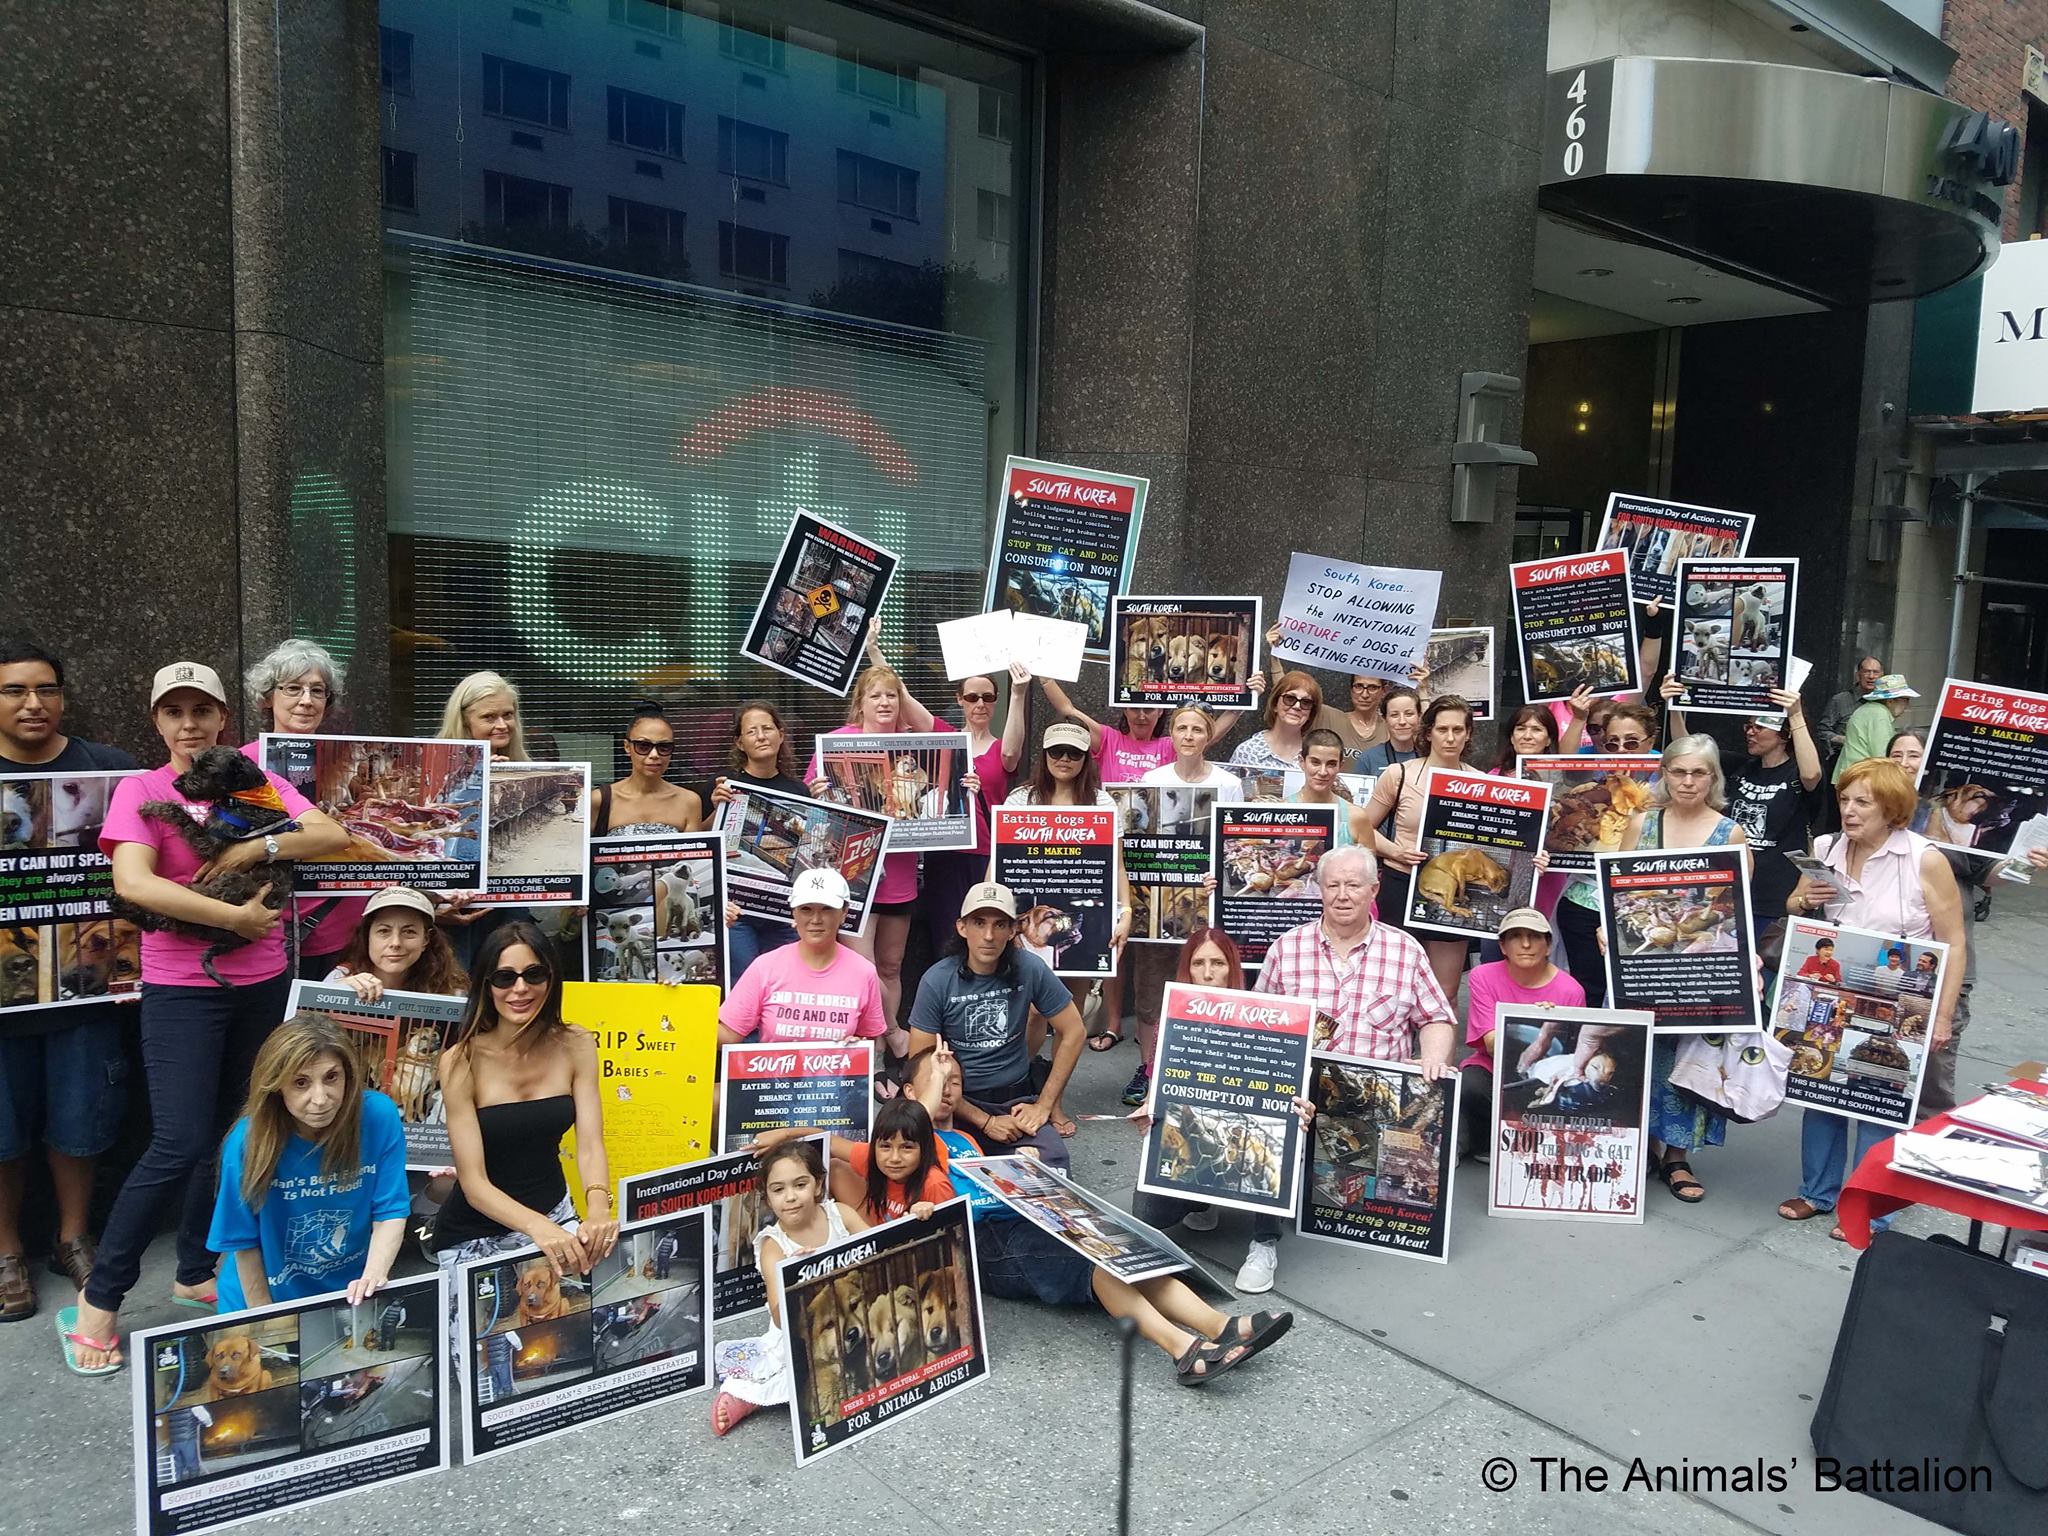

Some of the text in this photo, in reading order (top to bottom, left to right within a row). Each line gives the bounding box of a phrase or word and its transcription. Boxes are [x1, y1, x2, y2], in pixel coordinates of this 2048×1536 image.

[1564, 69, 1587, 176] 460
[1027, 478, 1117, 506] SOUTH KOREA
[1619, 501, 1664, 516] International
[1665, 509, 1680, 518] Day
[1690, 513, 1715, 523] Action
[1722, 517, 1742, 527] NYC
[817, 526, 877, 562] WARNING
[1007, 539, 1118, 562] STOP THE CAT AND DOG
[1005, 552, 1117, 577] CONSUMPION NOW!
[1529, 560, 1611, 582] SOUTH KOREA
[1126, 603, 1182, 614] SOUTH KOREA!
[1307, 583, 1415, 615] STOP ALLOWING
[1306, 604, 1416, 637] the INTENTIONAL
[1524, 621, 1544, 629] STOP
[1549, 618, 1564, 626] THE
[1569, 615, 1584, 623] CAT
[1525, 620, 1628, 641] CONSUMPTION NOW!
[1284, 616, 1414, 658] TORTURE of DOGS at
[1303, 643, 1349, 663] EATING
[1350, 655, 1416, 675] FESTIVALS
[1145, 693, 1162, 701] FOR
[1206, 694, 1239, 703] ABUSE!
[1953, 689, 2046, 713] Eating dogs
[1961, 706, 2007, 724] SOUTH
[1973, 726, 2034, 743] IS MAKING
[1003, 814, 1107, 826] Eating dogs in
[1014, 827, 1096, 845] SOUTH KOREA
[1141, 839, 1156, 848] CAN
[1158, 840, 1173, 849] NOT
[1175, 840, 1204, 849] SPEAK.
[20, 854, 74, 871] CAN NOT
[1128, 851, 1142, 860] they
[1156, 852, 1179, 860] always
[1180, 852, 1210, 861] speaking
[1133, 863, 1146, 872] you
[771, 991, 858, 1009] END THE KOREAN
[776, 1007, 849, 1024] DOG AND CAT
[1185, 998, 1290, 1029] SOUTH KOREA
[775, 1023, 807, 1036] MEAT
[1173, 1023, 1188, 1031] Cats
[1205, 1027, 1241, 1039] bludgeoned
[1258, 1035, 1280, 1043] thrown
[747, 1054, 851, 1074] SOUTH KOREA
[1165, 1068, 1296, 1095] STOP THE CAT AND DOG
[1791, 1077, 1807, 1086] THIS
[1819, 1083, 1841, 1094] WHAT
[1851, 1090, 1880, 1103] HIDDEN
[1882, 1097, 1906, 1107] FROM
[1162, 1084, 1296, 1114] CONSUMPTION NOW!
[1788, 1087, 1903, 1118] THE TOURIST IN SOUTH KOREA
[1501, 1128, 1544, 1153] STOP
[1524, 1162, 1612, 1184] MEAT TRADE
[283, 1179, 362, 1200] Is Not Food!
[1364, 1201, 1433, 1222] South Korea!
[1314, 1220, 1429, 1250] No More Cat Meat!
[797, 1241, 877, 1283] SOUTH KOREA!
[586, 1381, 607, 1392] BEST
[612, 1369, 646, 1385] FRIENDS
[651, 1356, 695, 1374] BETRAYED!
[843, 1349, 969, 1412] THERE IS NO CULTURAL JUSTIFICATION
[847, 1366, 970, 1432] FOR ANIMAL ABUSE!
